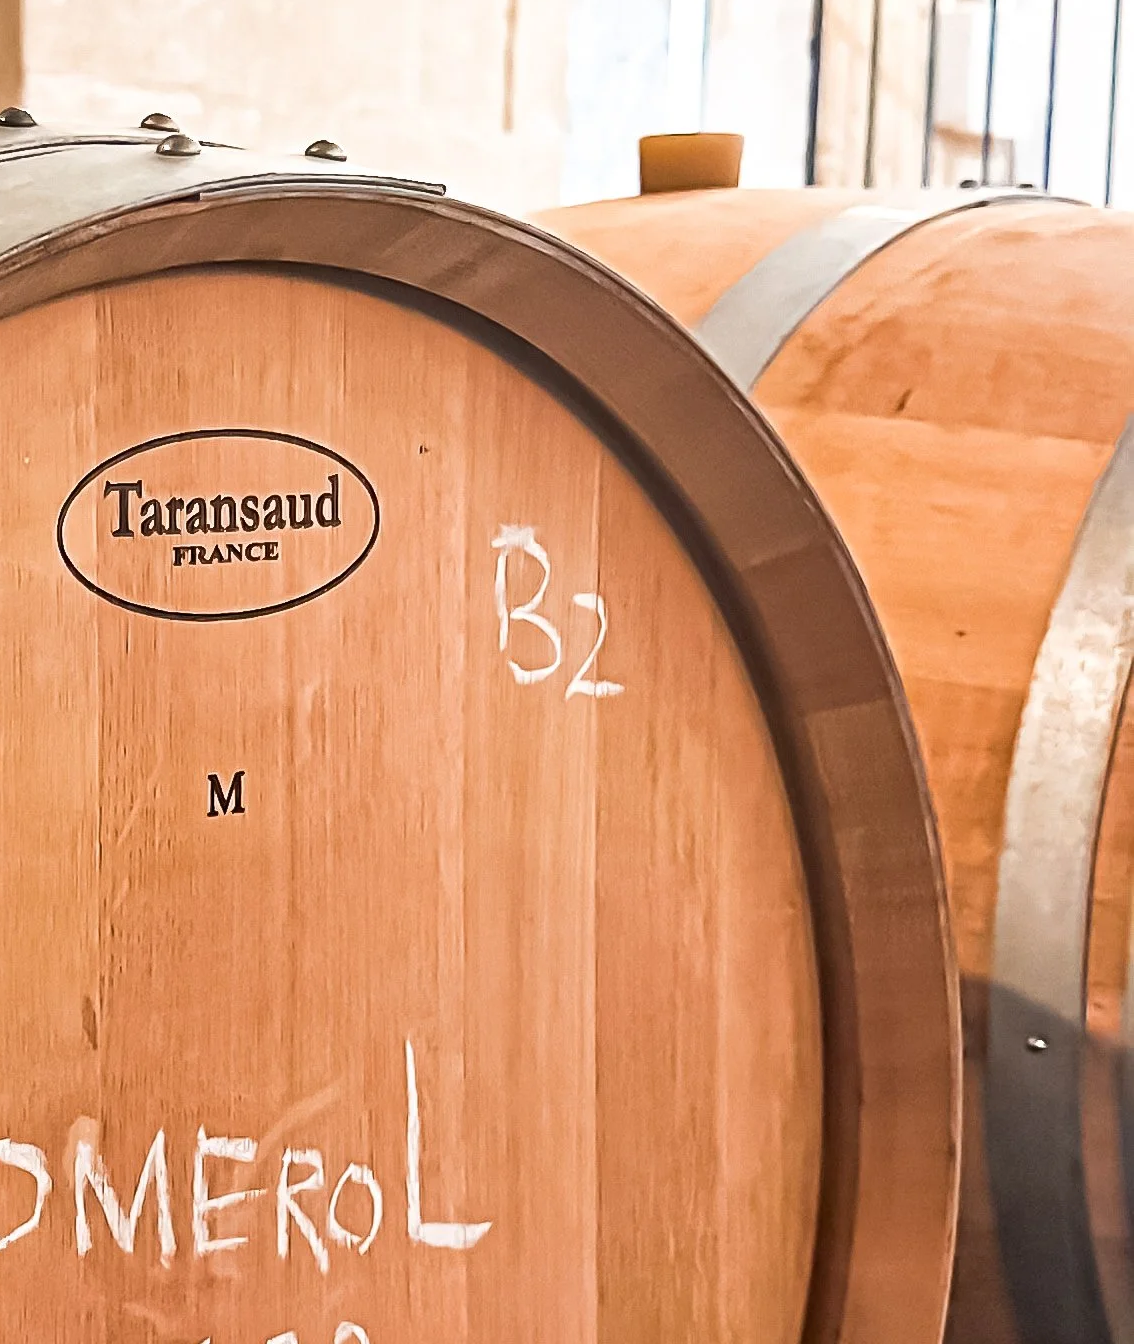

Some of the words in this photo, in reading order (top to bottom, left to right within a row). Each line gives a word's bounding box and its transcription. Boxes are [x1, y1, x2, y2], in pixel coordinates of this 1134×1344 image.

[103, 474, 341, 539] Taransaud
[172, 540, 279, 566] FRANCE
[491, 524, 626, 700] B2
[207, 771, 246, 817] M
